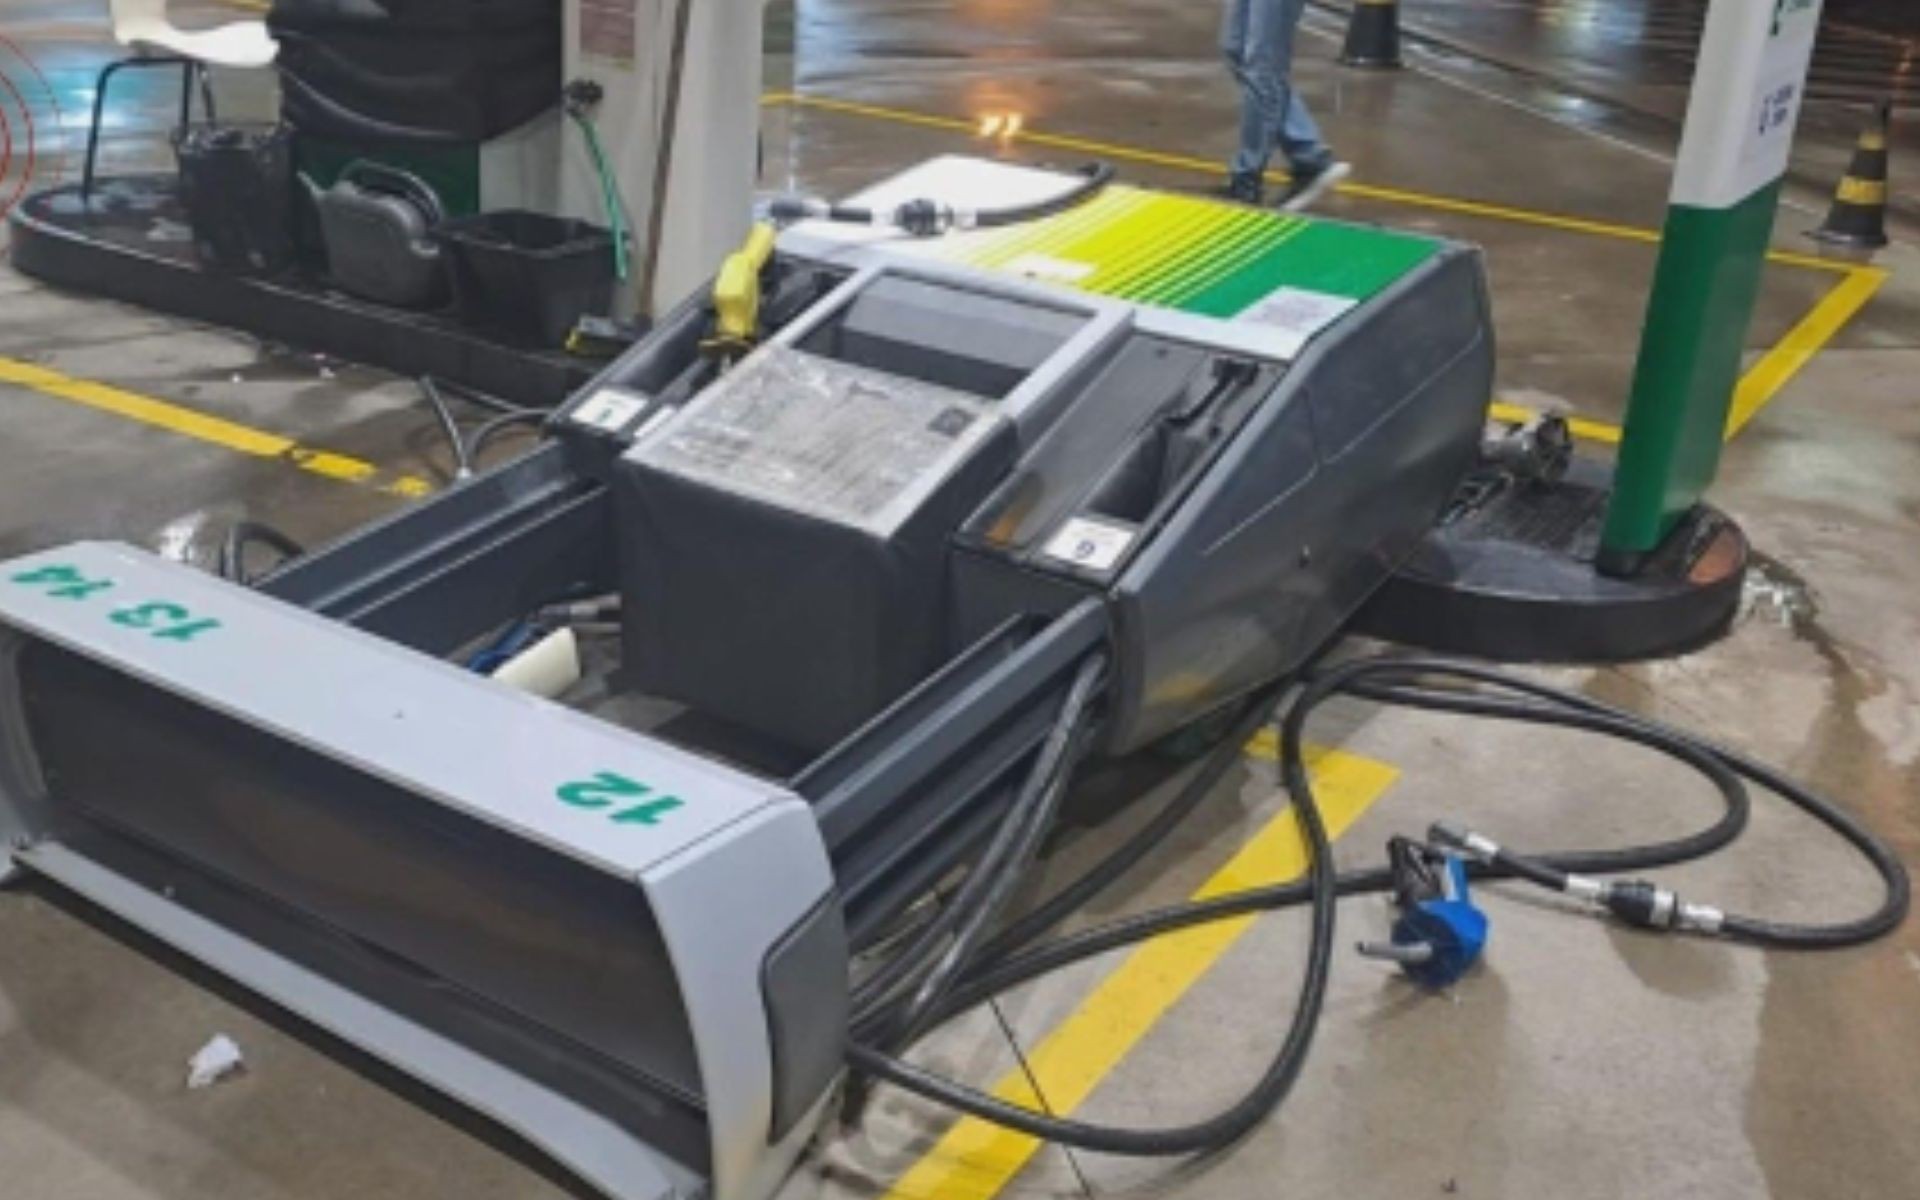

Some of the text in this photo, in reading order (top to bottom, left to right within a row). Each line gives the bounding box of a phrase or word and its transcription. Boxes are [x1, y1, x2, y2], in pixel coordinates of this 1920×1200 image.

[10, 563, 221, 641] 13 14
[555, 770, 686, 827] 12
